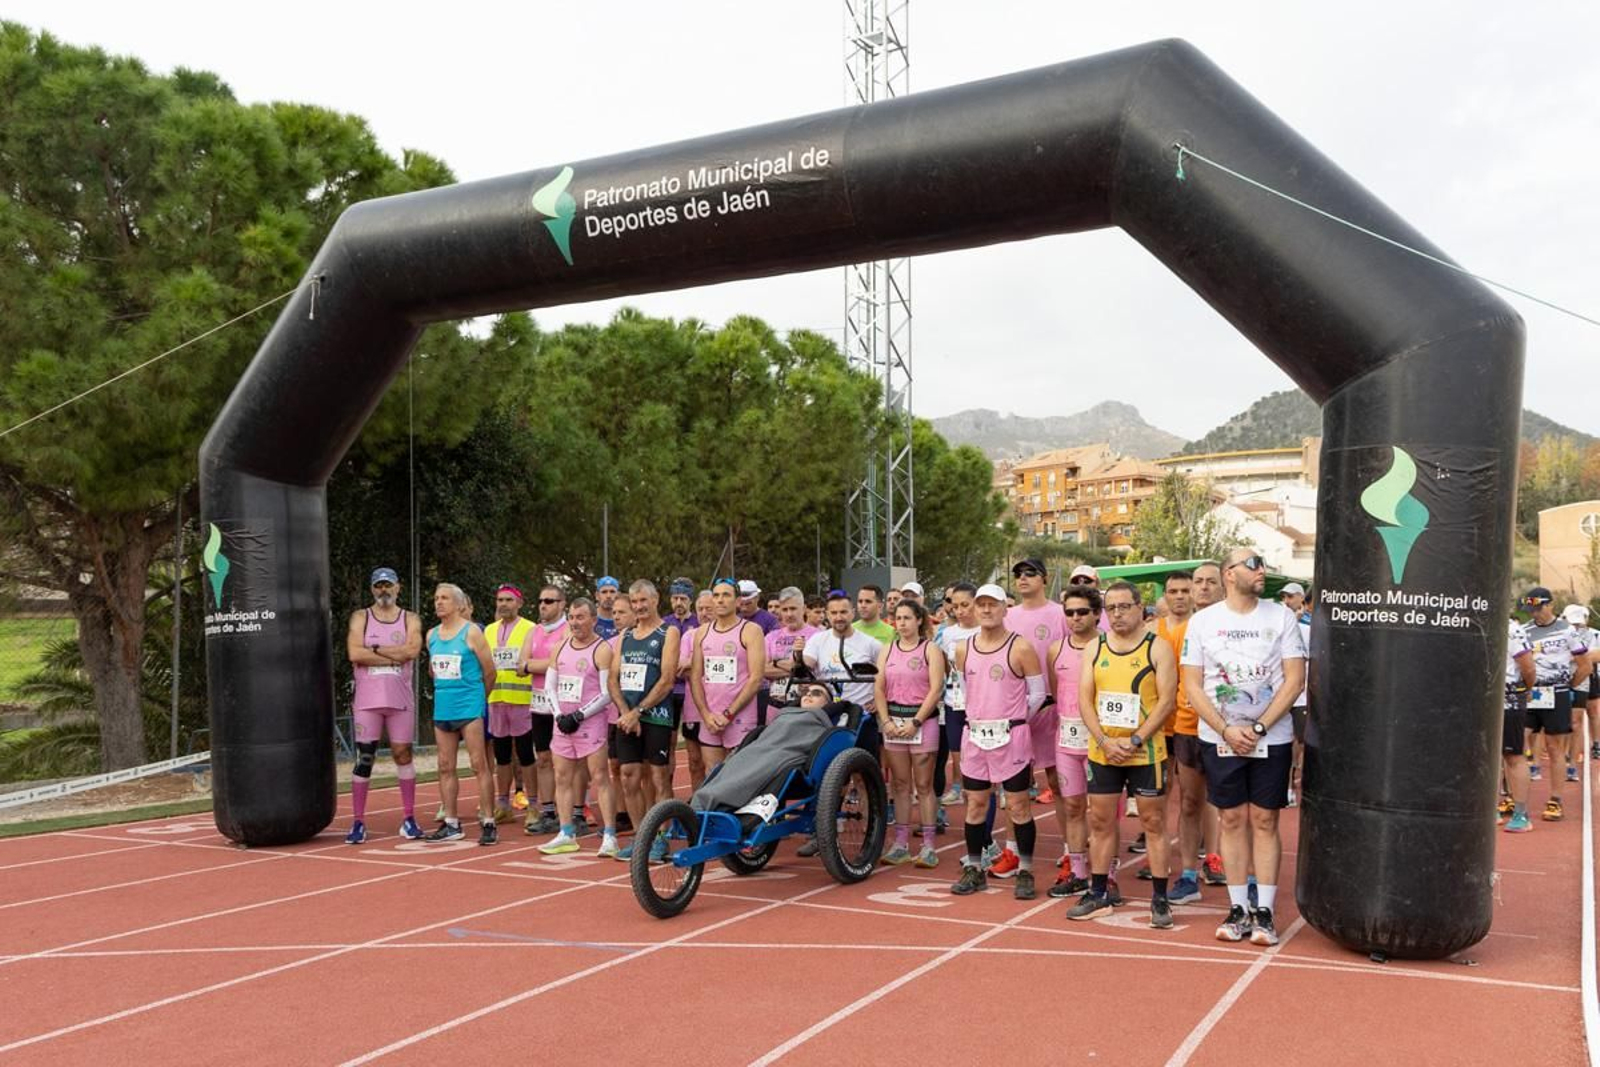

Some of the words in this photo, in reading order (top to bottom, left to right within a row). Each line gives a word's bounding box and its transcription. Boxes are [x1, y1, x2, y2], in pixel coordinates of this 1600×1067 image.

[584, 176, 681, 210] Patronato
[688, 151, 794, 191] Municipal
[801, 147, 830, 170] de
[584, 205, 678, 238] Deportes
[683, 197, 711, 219] de
[717, 186, 770, 215] Jaén
[1320, 589, 1381, 605] Patronato
[1386, 590, 1468, 612] Municipal
[1471, 598, 1489, 611] de
[214, 609, 258, 623] Municipal
[261, 609, 276, 619] de
[1331, 607, 1398, 625] Deportes
[1403, 609, 1426, 625] de
[1431, 611, 1470, 628] Jaén
[222, 623, 234, 632] de
[236, 621, 262, 632] Jaén
[498, 652, 513, 660] 123
[439, 661, 450, 669] 87
[712, 663, 725, 673] 48
[1106, 701, 1123, 713] 89
[981, 728, 994, 737] 11
[1070, 726, 1078, 737] 9
